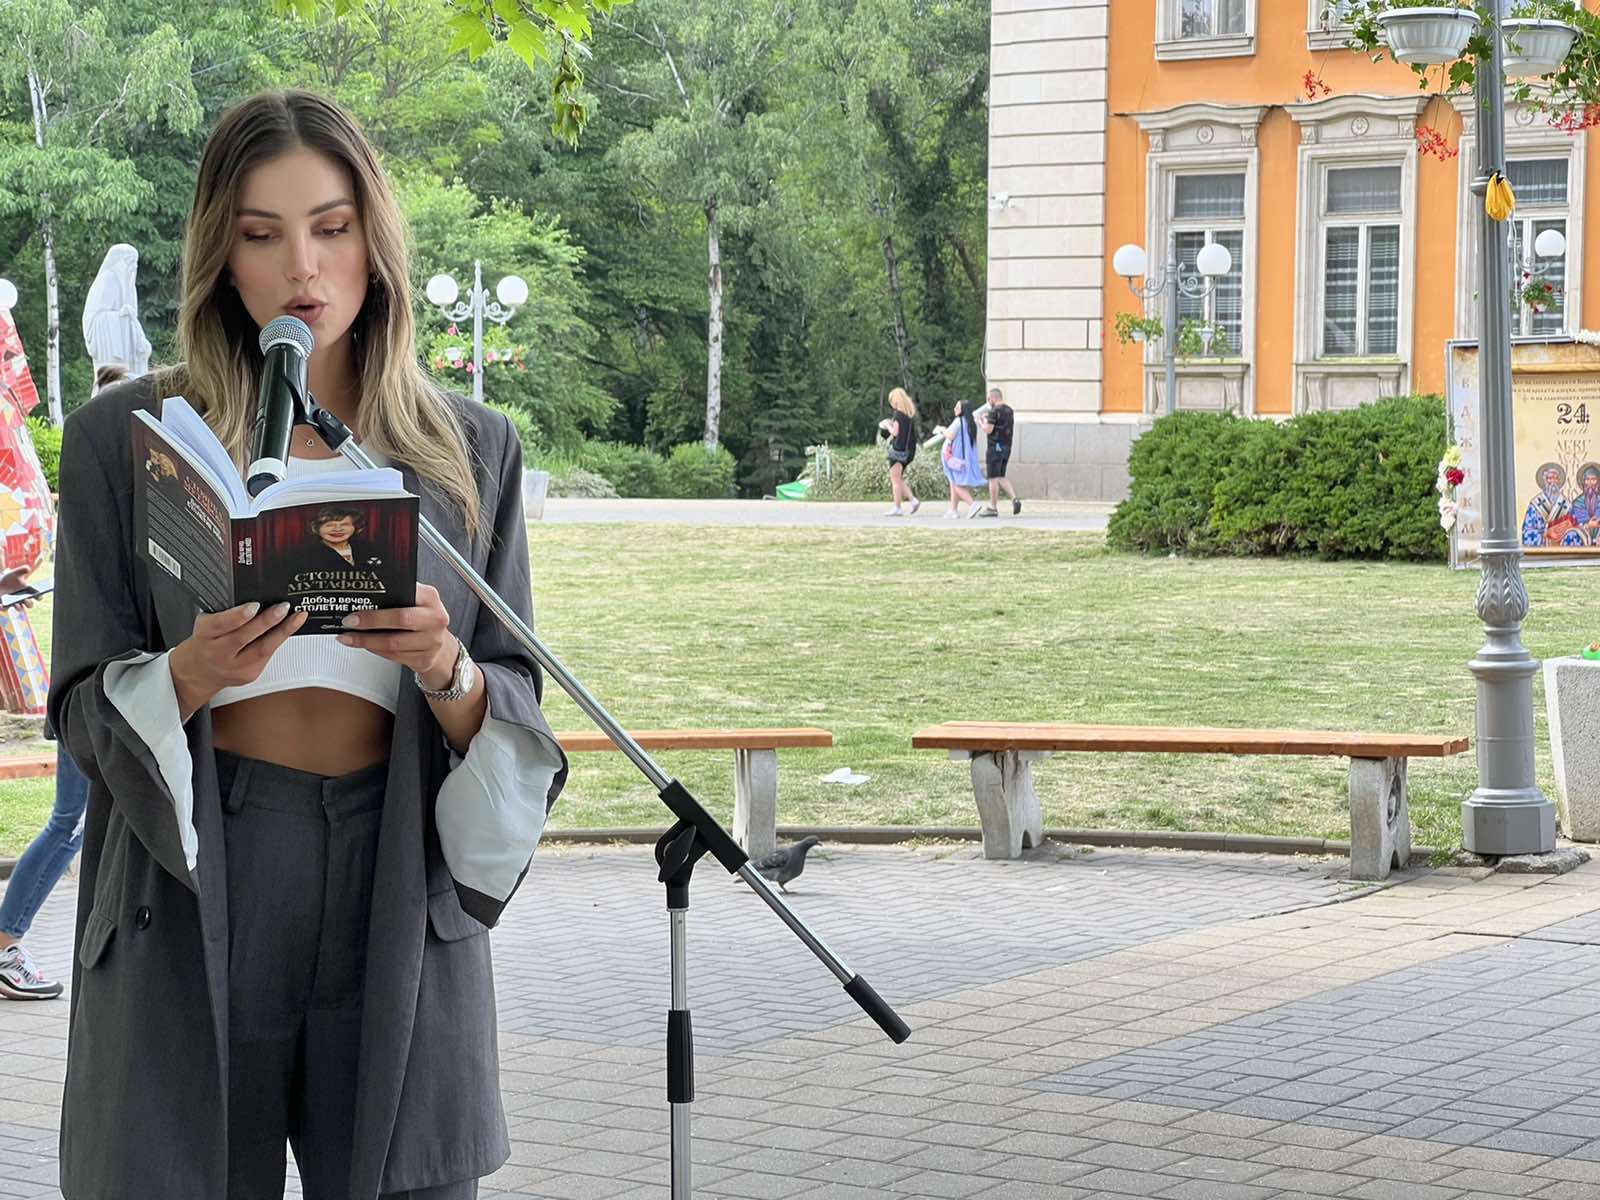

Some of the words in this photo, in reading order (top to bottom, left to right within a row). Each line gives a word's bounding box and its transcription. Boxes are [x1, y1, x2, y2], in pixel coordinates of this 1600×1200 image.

[1556, 402, 1590, 425] 24
[294, 571, 379, 582] СТОЯНКА
[287, 580, 386, 592] МУТАФОВА
[302, 596, 337, 605] Добър
